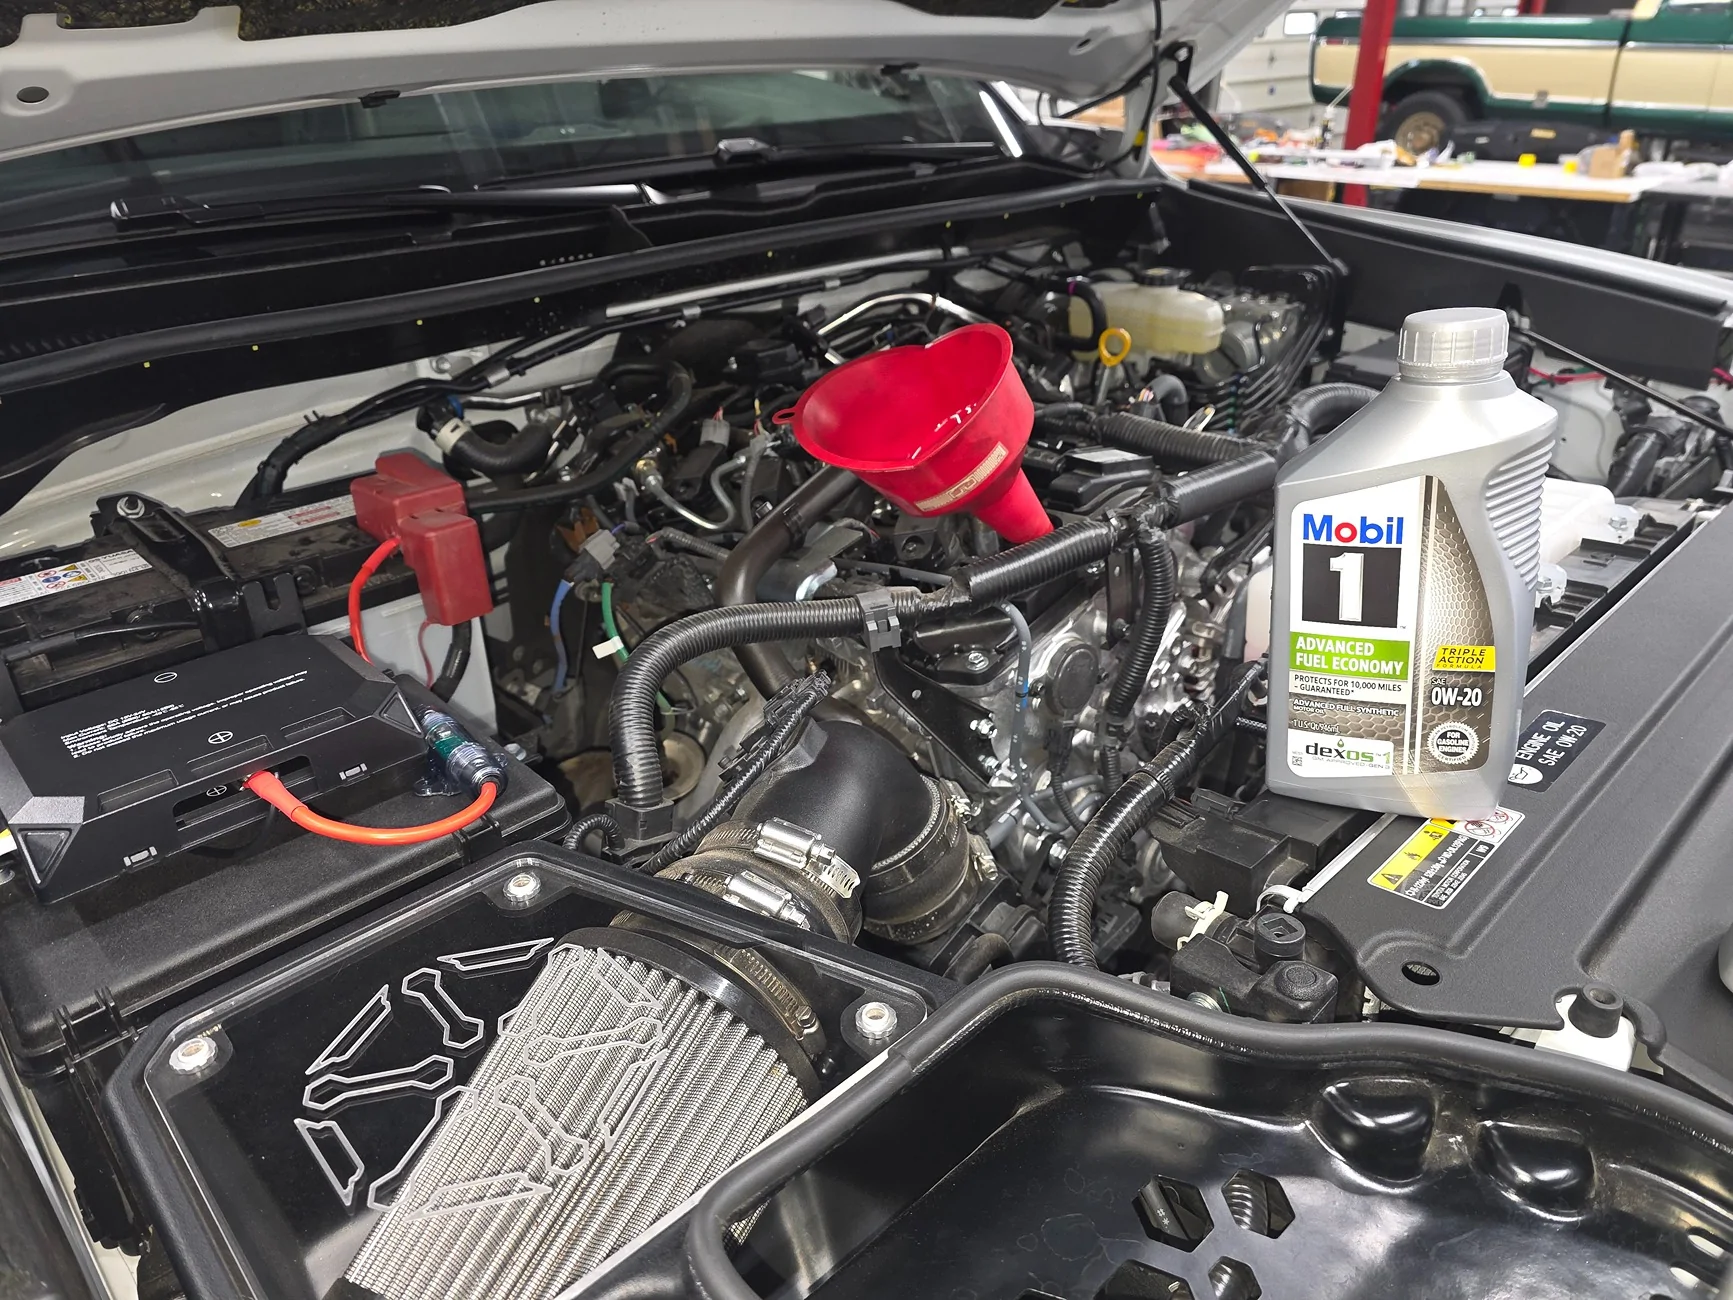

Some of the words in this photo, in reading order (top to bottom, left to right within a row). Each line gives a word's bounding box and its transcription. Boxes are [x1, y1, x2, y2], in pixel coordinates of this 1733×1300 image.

[1303, 513, 1404, 545] Mobil
[1329, 552, 1364, 623] 1
[1295, 635, 1375, 656] ADVANCED
[1441, 648, 1487, 657] TRIPLE
[1295, 652, 1329, 669] FUEL
[1332, 656, 1404, 675] ECONOMY
[1438, 656, 1484, 664] ACTION
[1294, 674, 1332, 685] PROTECTS
[1333, 679, 1349, 688] FOR
[1351, 681, 1376, 690] 10,000
[1377, 682, 1402, 692] MILES
[1431, 677, 1447, 685] SAE
[1431, 686, 1482, 707] 0W-20
[1293, 698, 1335, 711] ADVANCED
[1336, 704, 1354, 712] FULL
[1356, 706, 1400, 717] SYNTHETIC
[1436, 738, 1469, 746] GASOLINE
[1515, 732, 1551, 760] ENGINE
[1541, 721, 1566, 732] OIL
[1305, 742, 1374, 763] dexos
[1538, 748, 1565, 766] SAE
